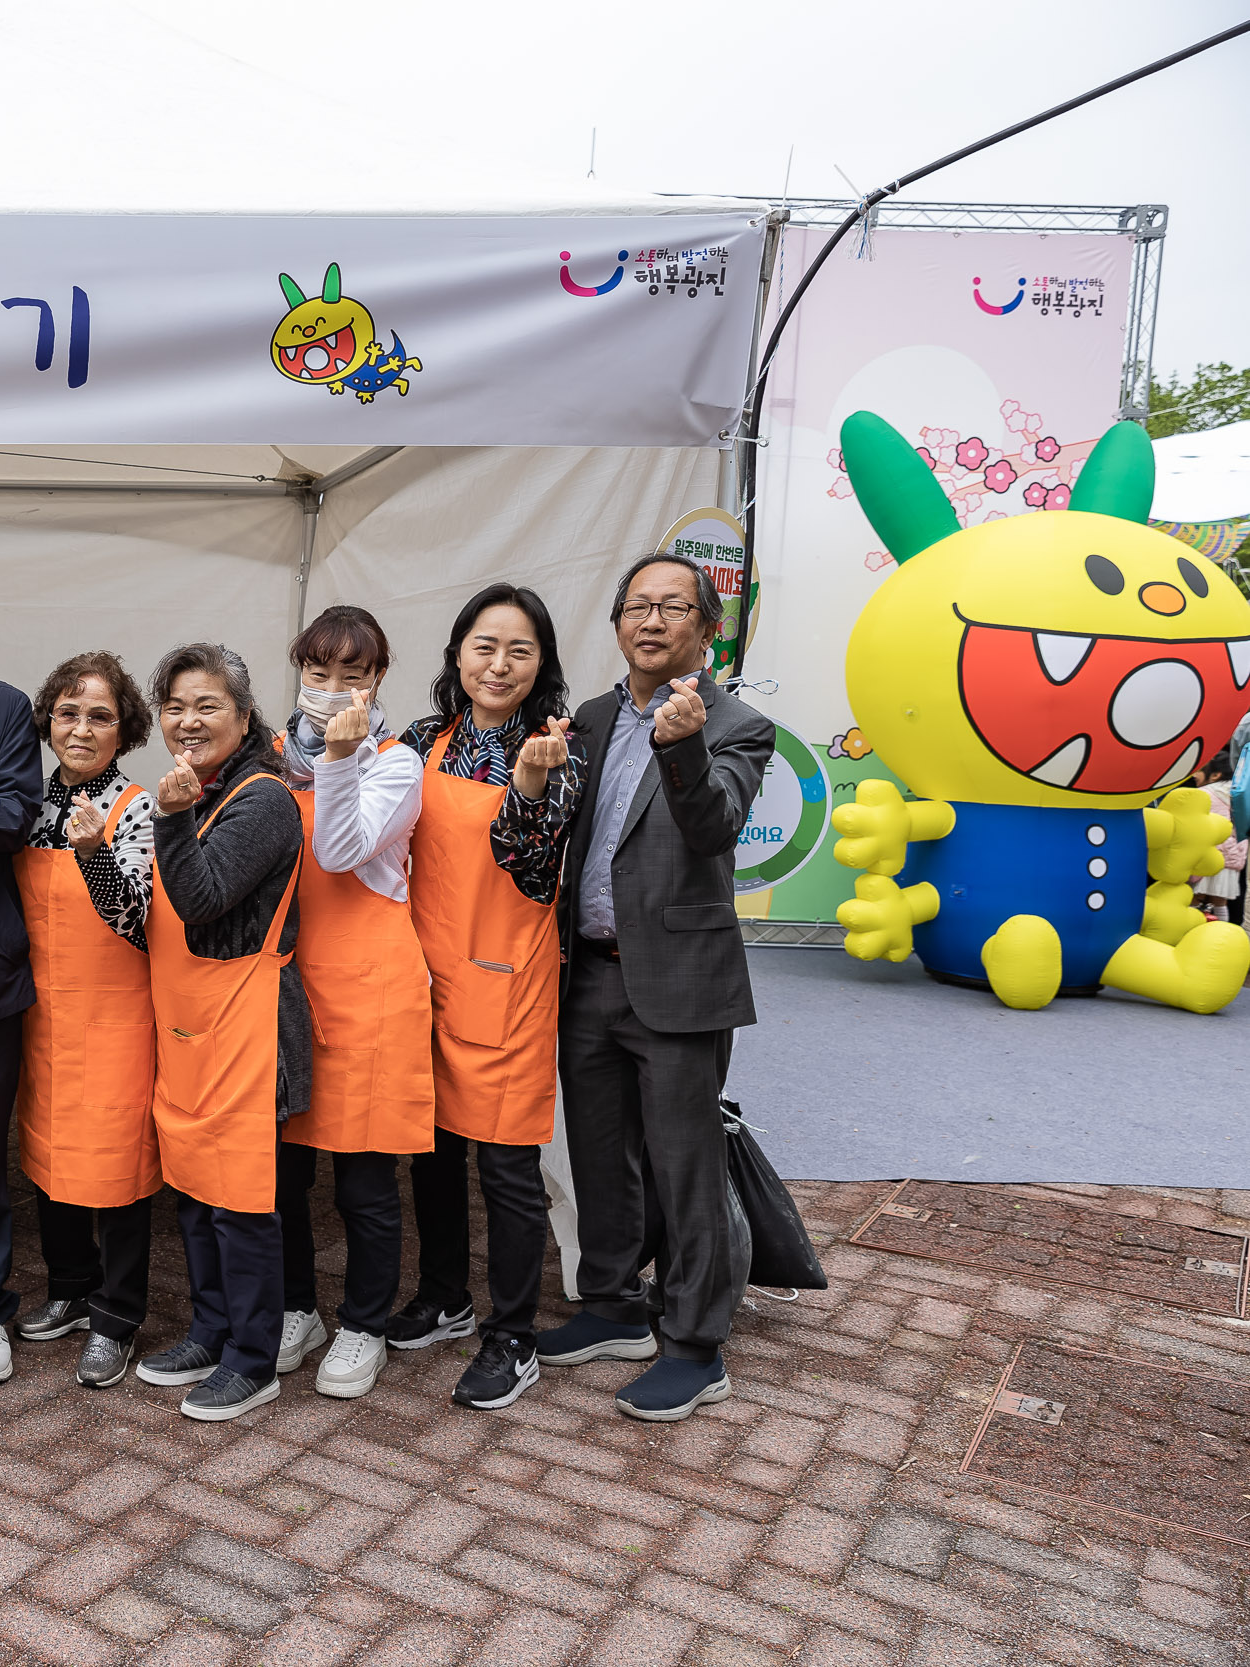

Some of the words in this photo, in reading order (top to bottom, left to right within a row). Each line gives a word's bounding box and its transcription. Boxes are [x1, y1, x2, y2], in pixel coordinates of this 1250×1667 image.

[635, 248, 679, 268] 소통하며
[681, 246, 729, 265] 발전하는
[634, 263, 727, 299] 행복광진
[1032, 276, 1067, 292] 소통하며
[1068, 278, 1105, 293] 발전하는
[1031, 291, 1104, 318] 행복광진
[674, 539, 714, 560] 일주일에
[715, 544, 744, 564] 한번은
